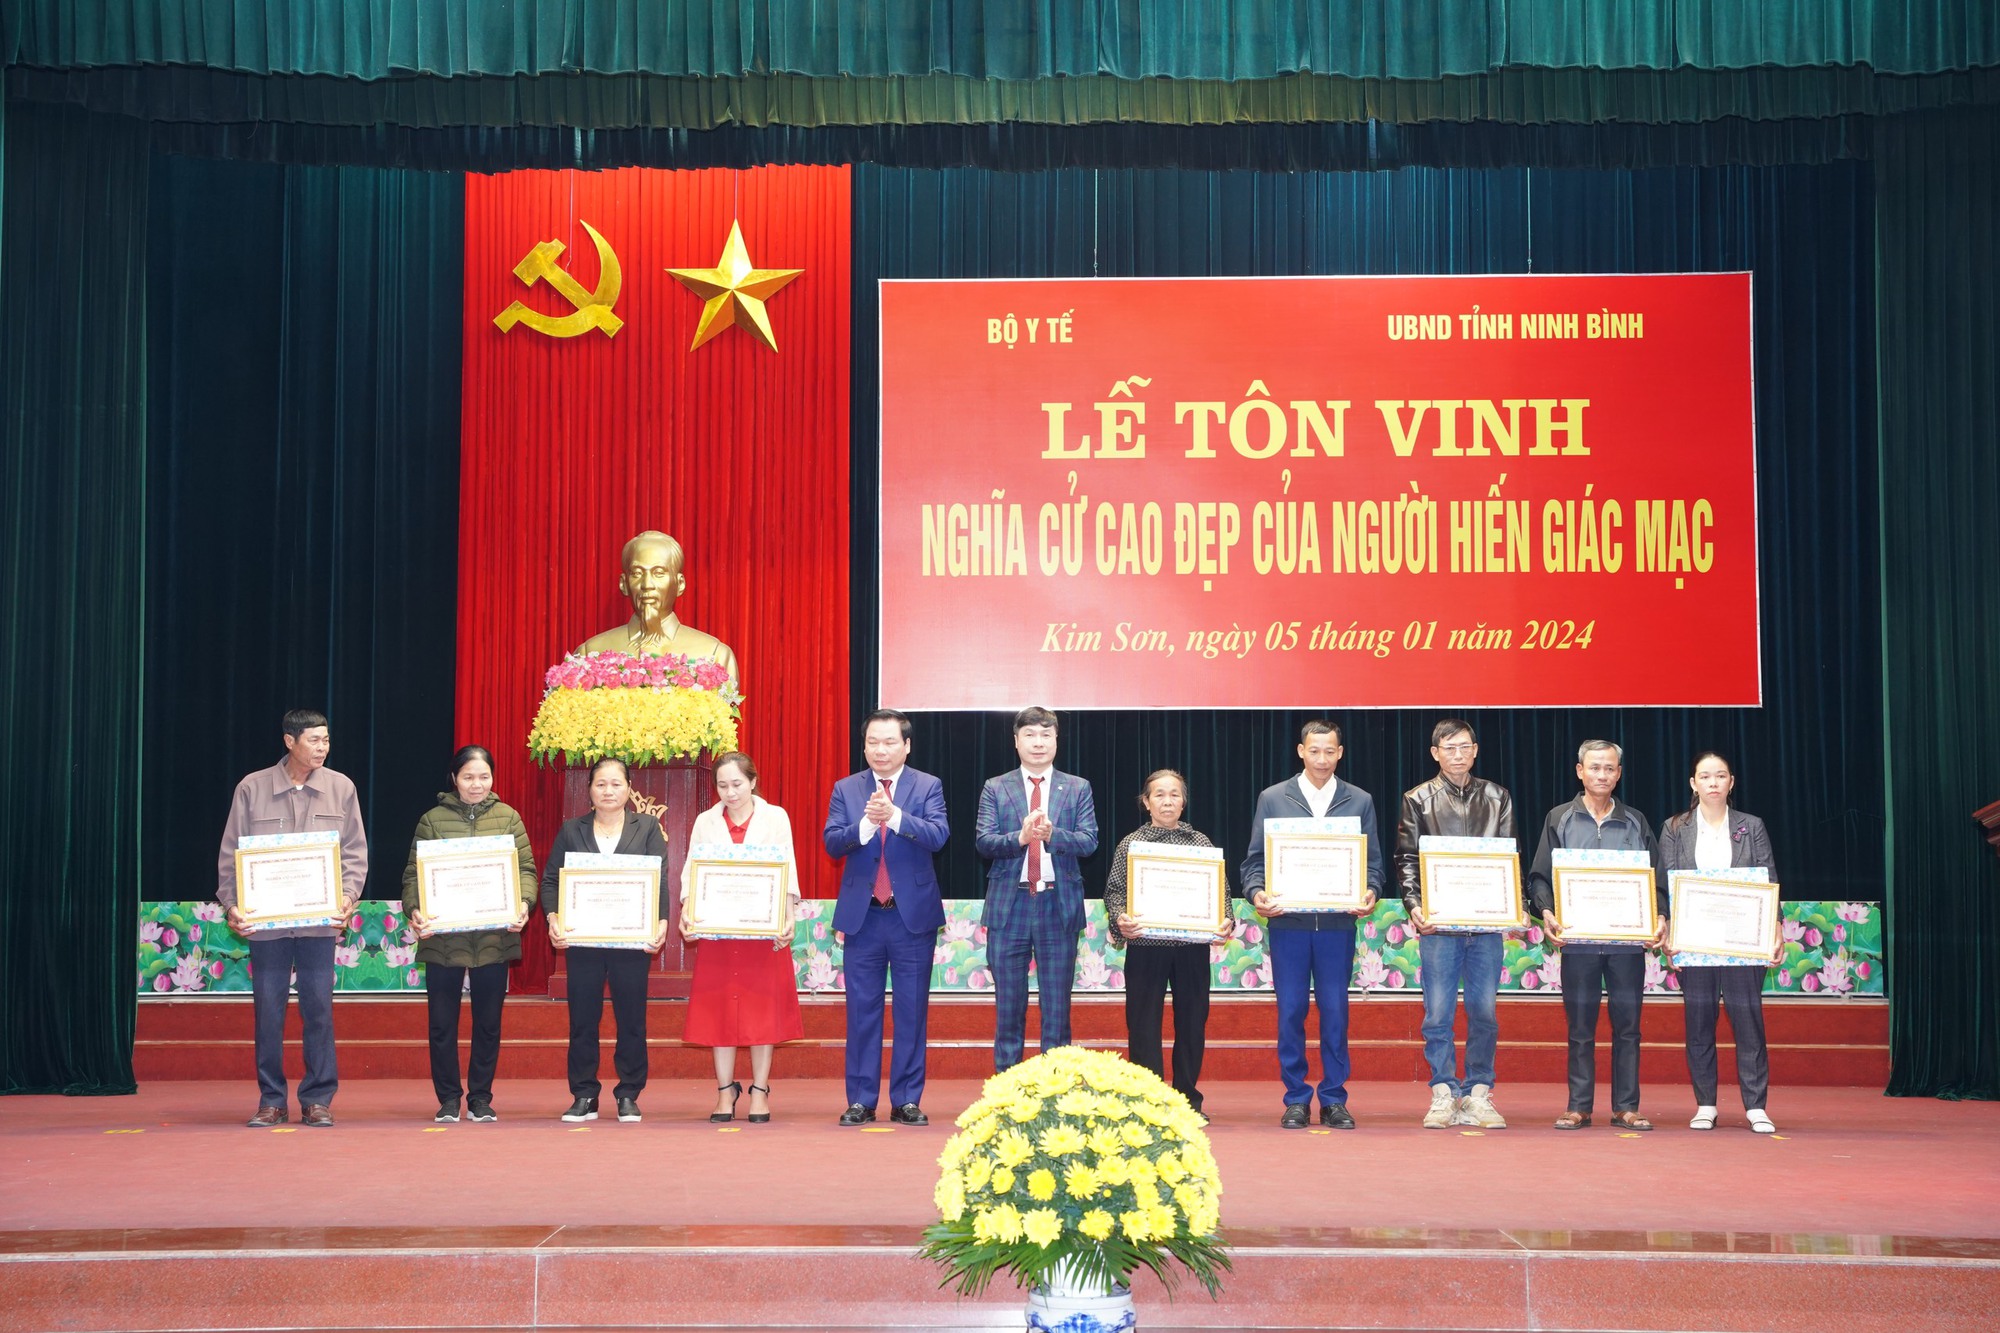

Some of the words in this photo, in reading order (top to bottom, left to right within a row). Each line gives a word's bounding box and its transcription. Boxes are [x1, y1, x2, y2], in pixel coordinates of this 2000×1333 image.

[987, 312, 1019, 350] BỘ
[1025, 317, 1040, 344] Y
[1046, 308, 1074, 343] TẾ
[1387, 314, 1452, 341] UBND
[1458, 304, 1512, 340] TỈNH
[1520, 313, 1579, 340] NINH
[1587, 307, 1644, 339] BÌNH
[1040, 375, 1153, 460] LỄ
[1174, 379, 1352, 459] TÔN
[1374, 398, 1591, 457] VINH
[922, 488, 1028, 577] NGHĨA
[1038, 470, 1088, 576] CỬ
[1095, 502, 1163, 575] CAO
[1173, 502, 1241, 592] ĐẸP
[1252, 468, 1322, 575] CỦA
[1332, 480, 1438, 575] NGƯỜI
[1449, 472, 1531, 574] HIẾN
[1542, 483, 1623, 574] GIÁC
[1635, 498, 1714, 590] MẠC
[1039, 622, 1102, 652] Kim
[1110, 622, 1175, 658] Sơn,
[1185, 622, 1257, 659] ngày
[1264, 621, 1302, 651] 05
[1308, 620, 1396, 659] tháng
[1402, 620, 1438, 651] 01
[1447, 621, 1513, 651] năm
[1519, 619, 1593, 650] 2024
